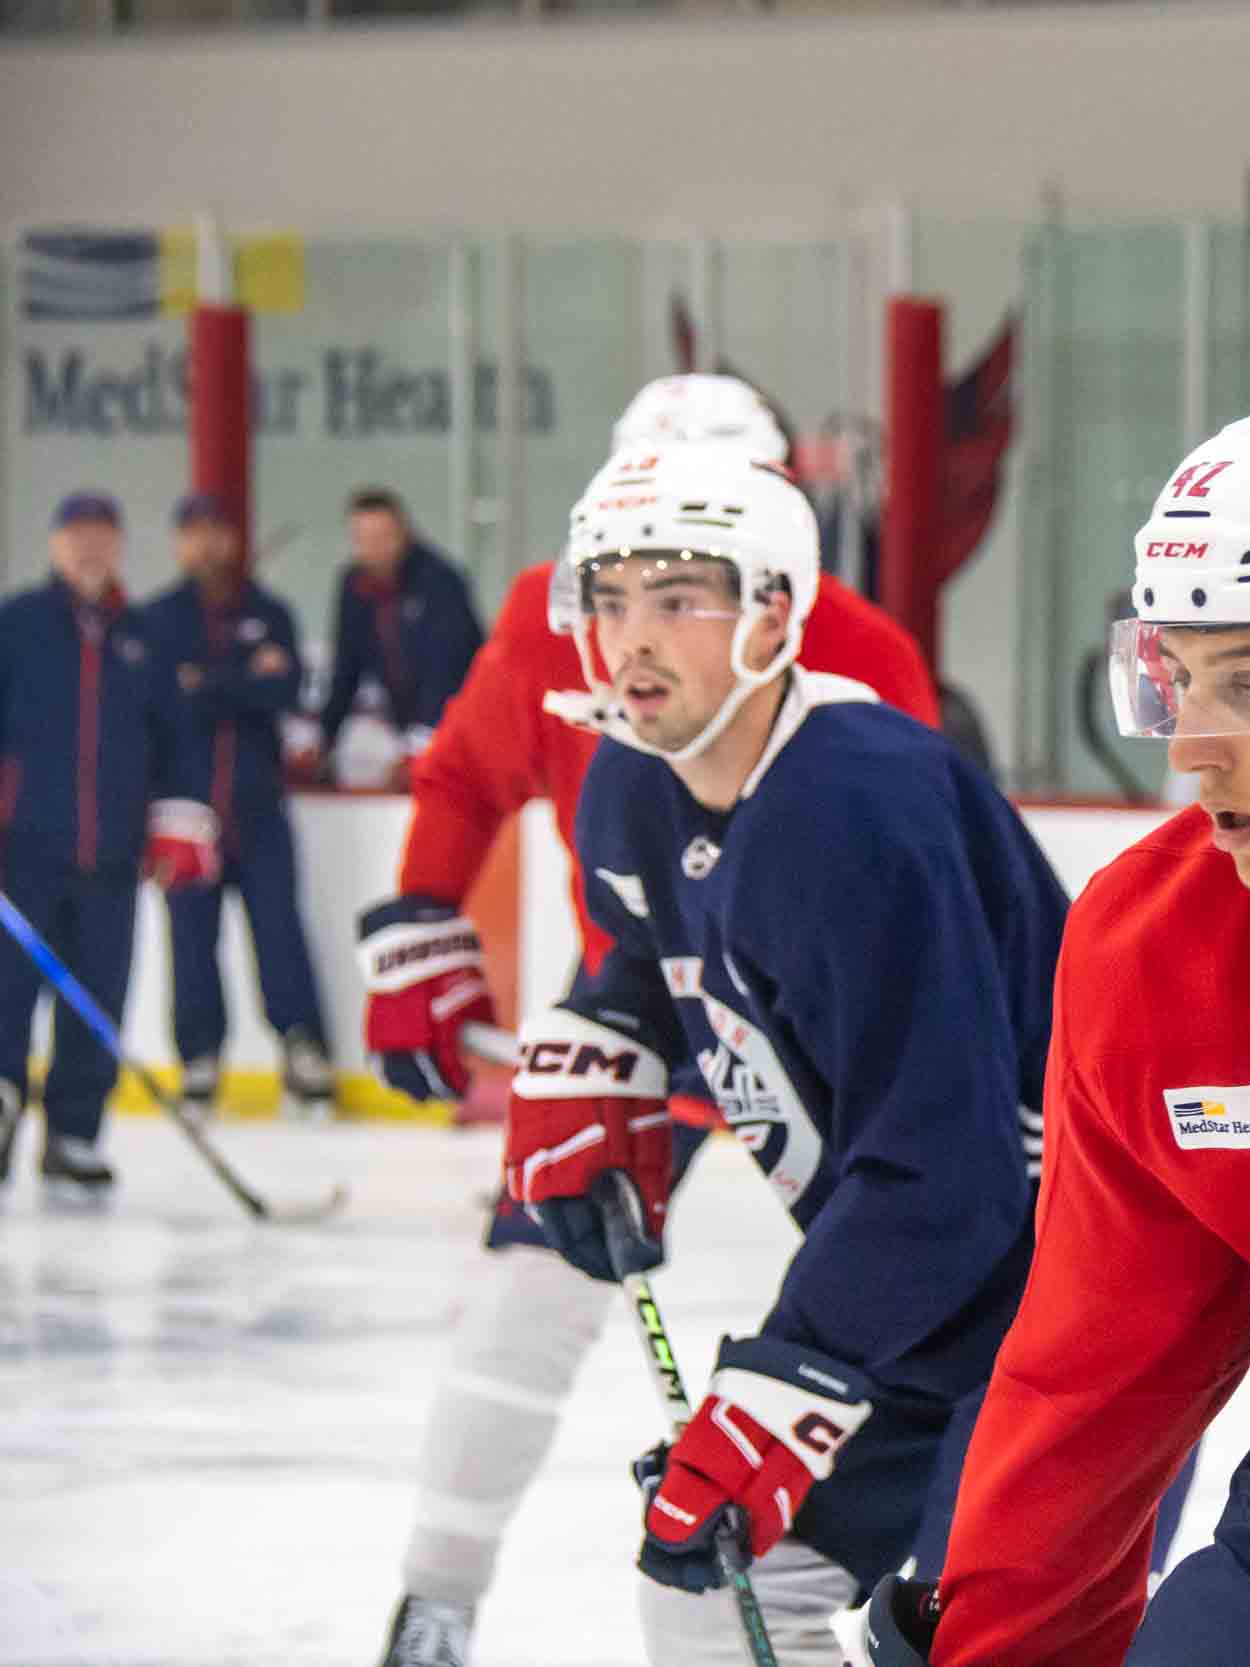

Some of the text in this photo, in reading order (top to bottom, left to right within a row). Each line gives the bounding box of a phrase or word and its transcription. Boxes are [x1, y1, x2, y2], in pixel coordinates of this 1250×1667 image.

[1172, 461, 1234, 497] 42
[1146, 541, 1209, 558] CCM
[1179, 1120, 1229, 1135] MedStar
